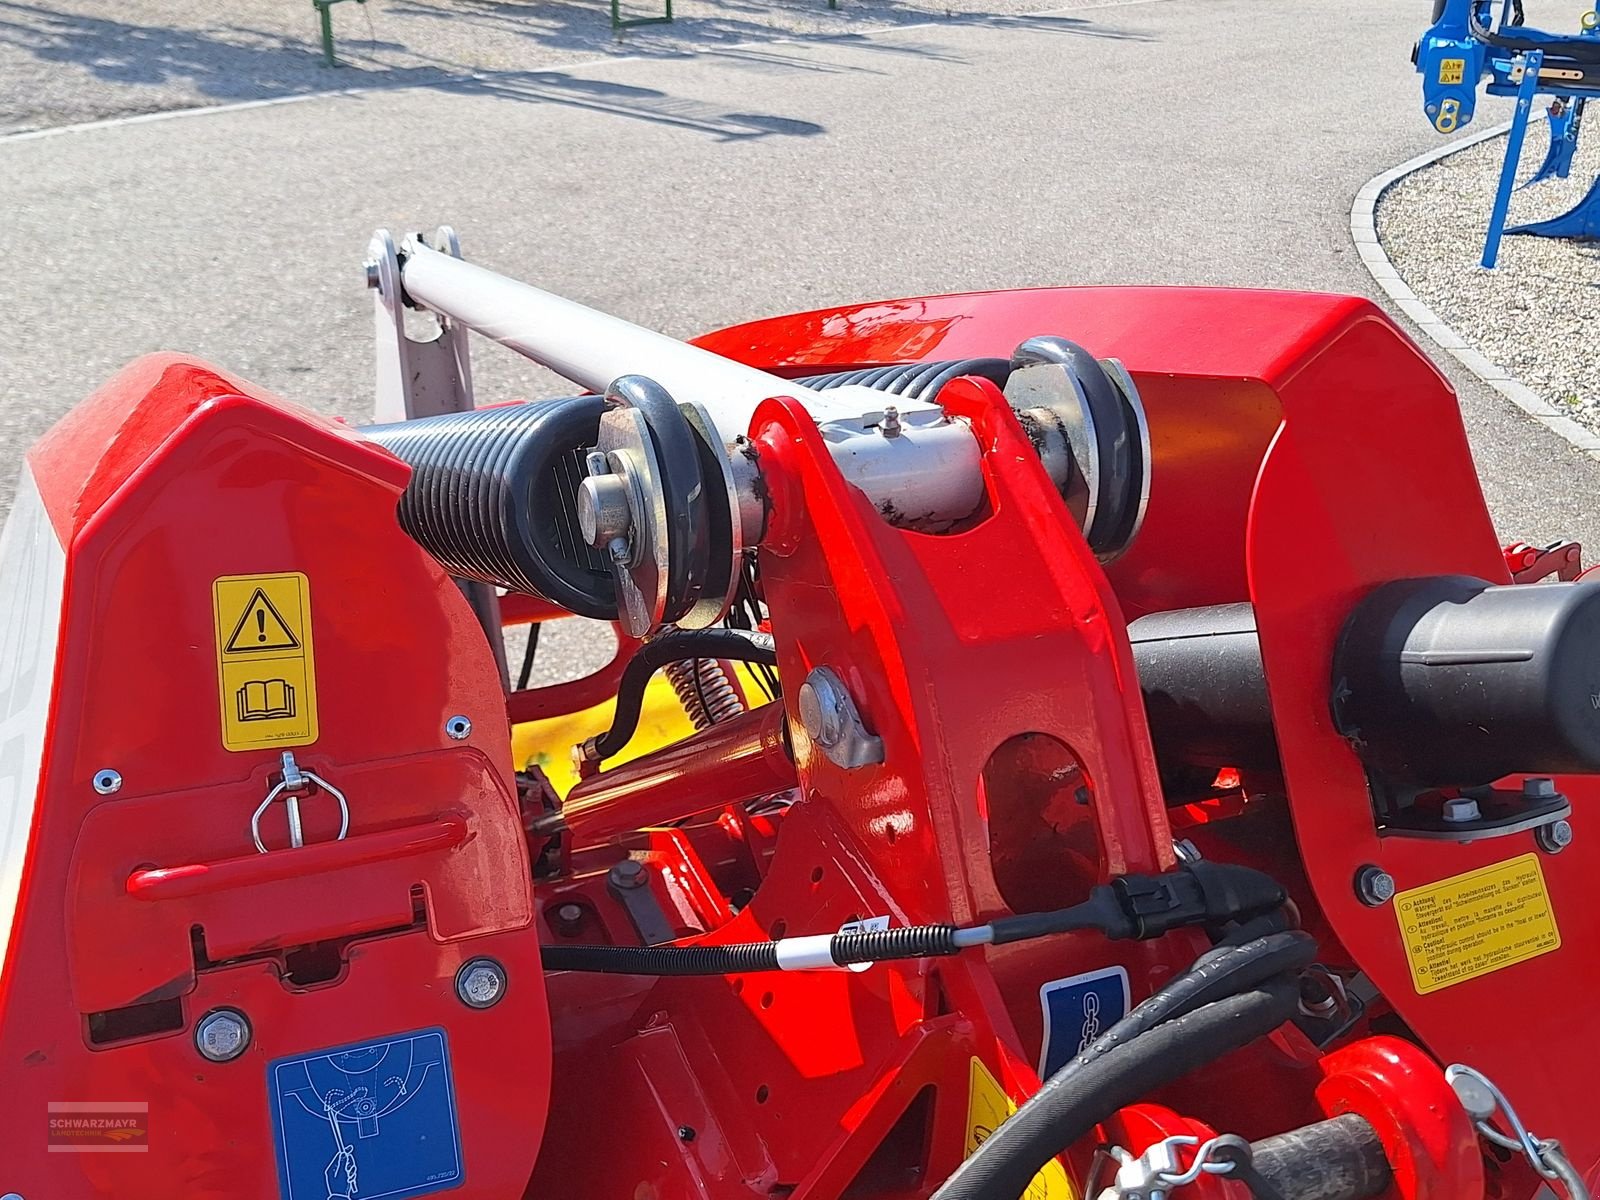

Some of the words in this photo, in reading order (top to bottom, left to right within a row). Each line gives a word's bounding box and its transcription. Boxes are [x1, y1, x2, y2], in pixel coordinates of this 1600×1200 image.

[1412, 895, 1436, 907] Achtung!
[1417, 915, 1443, 927] Attention!
[1423, 937, 1444, 948] Caution!
[1435, 940, 1458, 952] hydraulic
[1458, 934, 1475, 944] control
[1476, 929, 1491, 938] should
[1446, 946, 1461, 956] during
